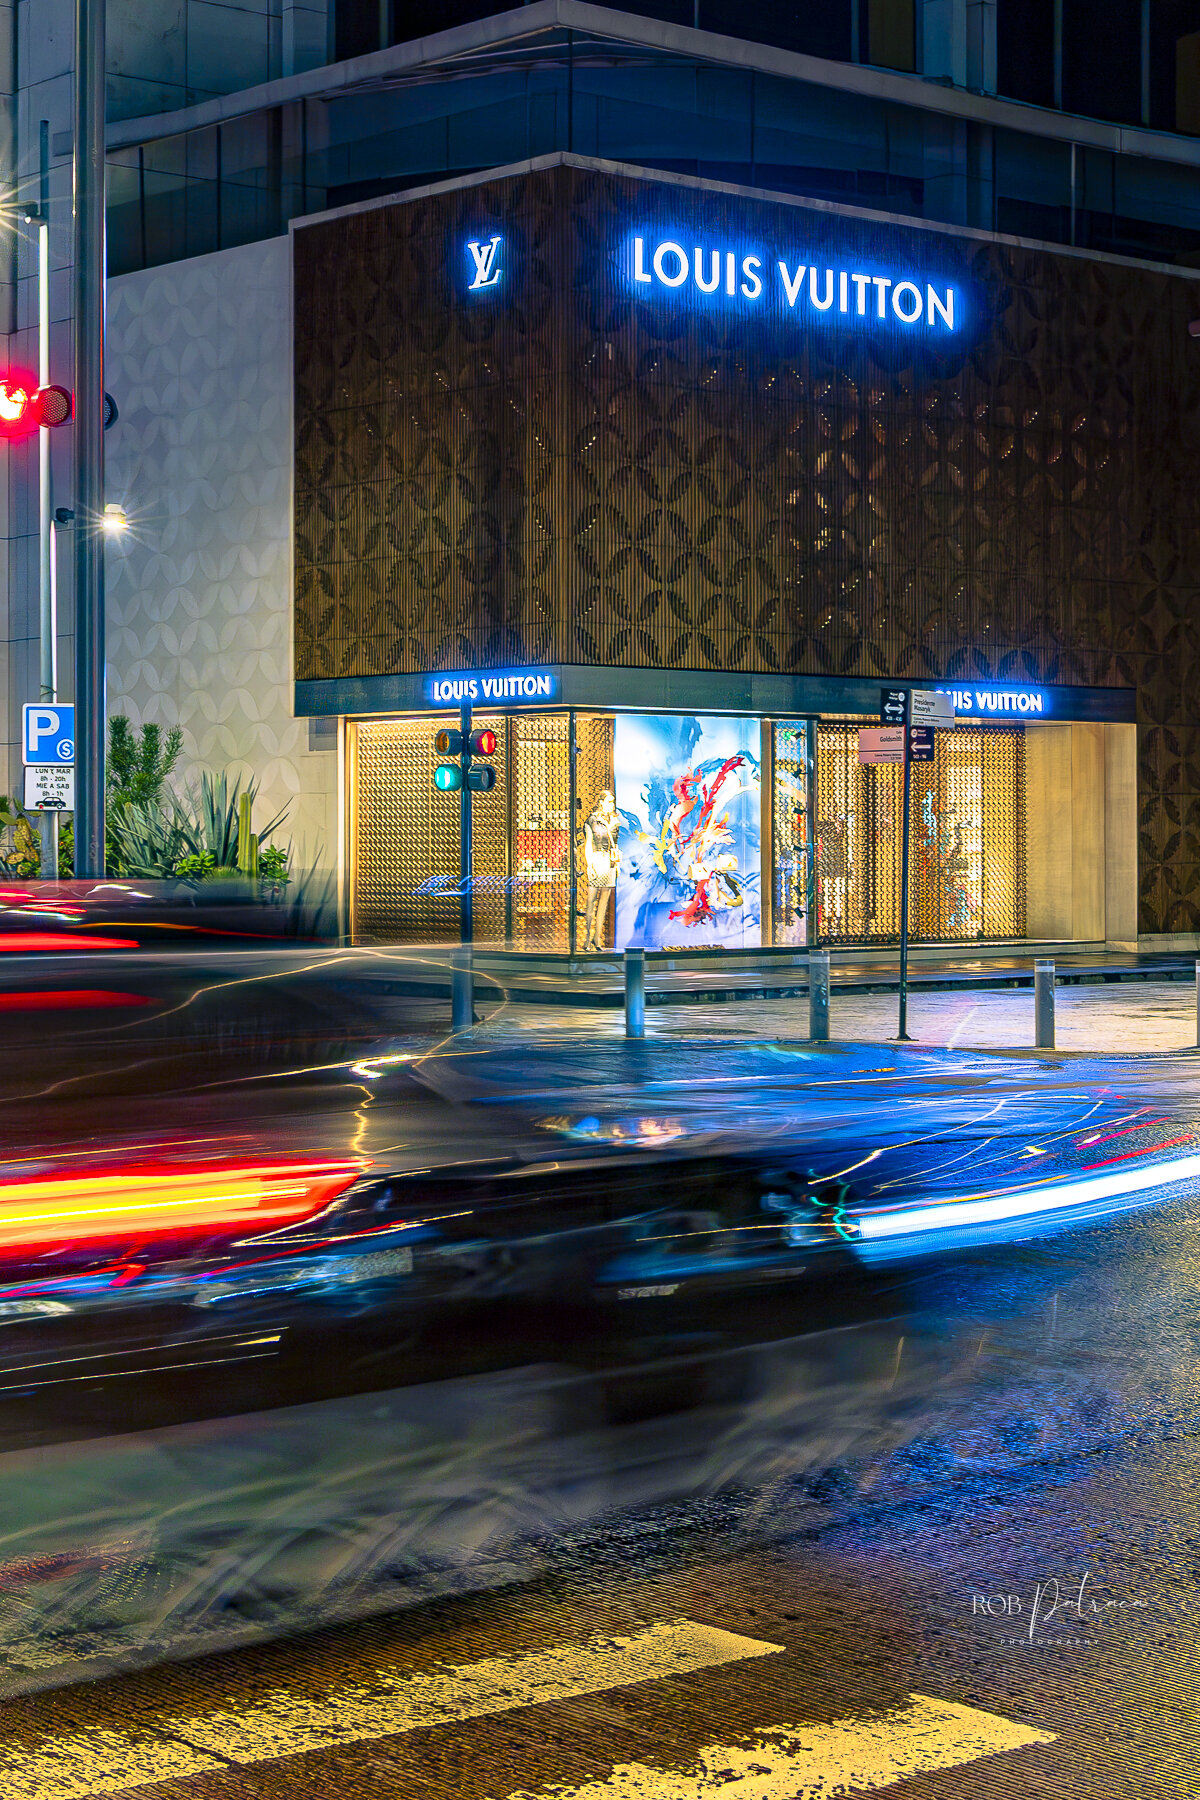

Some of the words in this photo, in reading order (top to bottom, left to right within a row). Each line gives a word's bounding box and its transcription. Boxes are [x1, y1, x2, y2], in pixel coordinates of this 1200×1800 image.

[634, 237, 762, 299] LOUIS
[779, 261, 954, 331] VUITTON
[433, 679, 478, 701] LOUIS
[481, 675, 550, 698] VUITTON
[975, 692, 1043, 712] VUITTON
[28, 709, 60, 752] P
